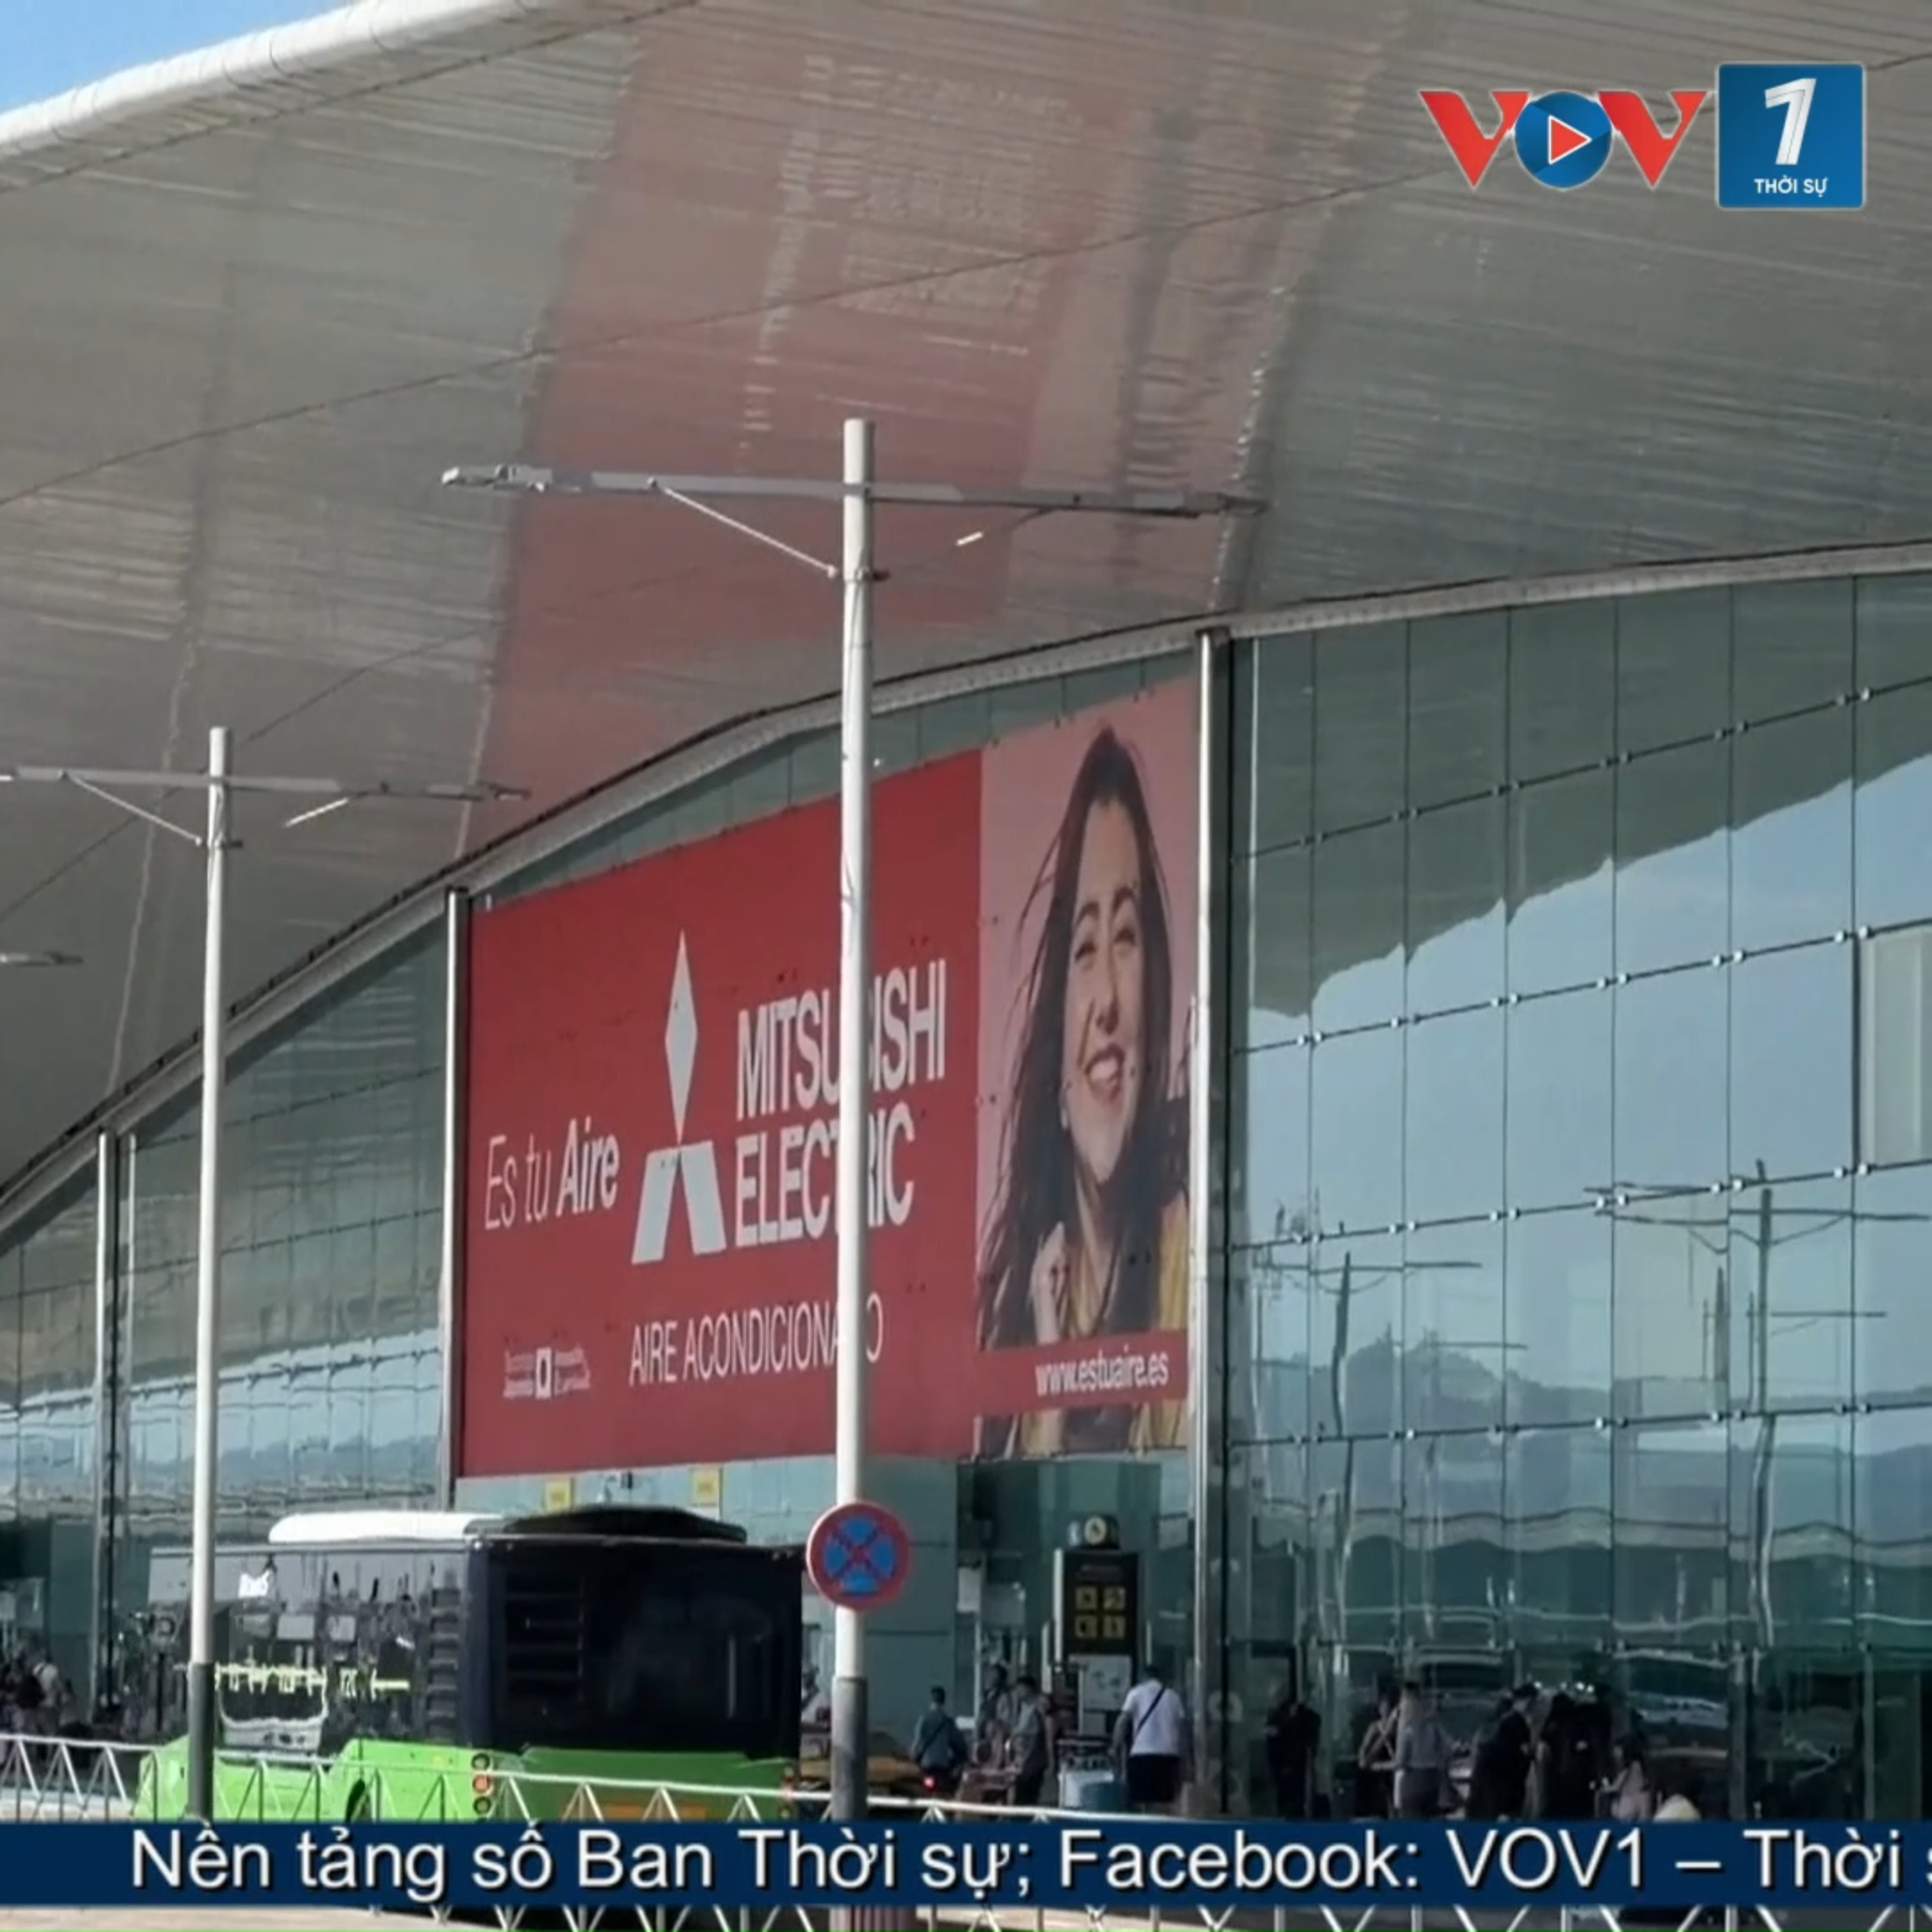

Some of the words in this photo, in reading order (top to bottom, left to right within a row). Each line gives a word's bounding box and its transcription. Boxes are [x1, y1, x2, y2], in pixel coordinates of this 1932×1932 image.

[737, 959, 946, 1121] MITSUISHI
[484, 1135, 517, 1229] Es
[525, 1133, 551, 1223] tu
[556, 1116, 620, 1217] Aire
[629, 1321, 677, 1386] AIRE
[1035, 1343, 1169, 1397] www.estuaire.es
